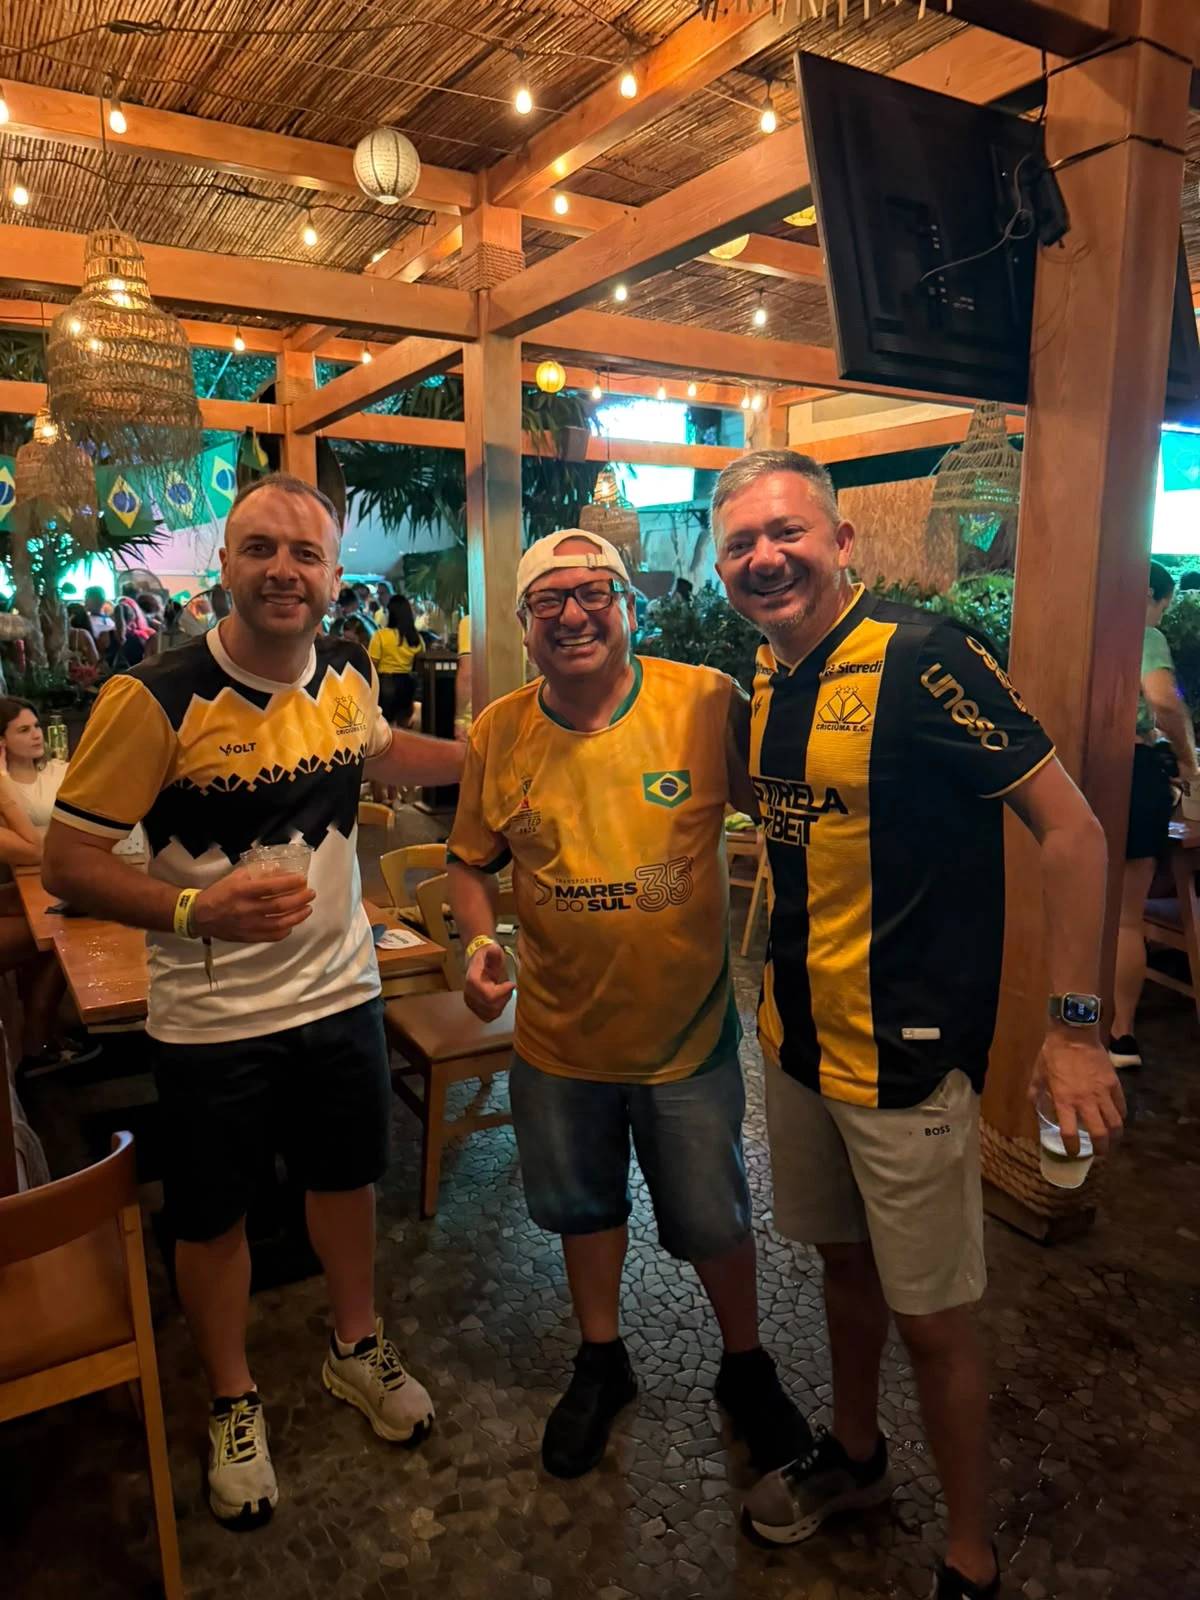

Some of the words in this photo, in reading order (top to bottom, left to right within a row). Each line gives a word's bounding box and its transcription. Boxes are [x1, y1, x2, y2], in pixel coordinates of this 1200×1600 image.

[838, 660, 883, 674] Sicredi
[219, 742, 256, 756] VOLT
[771, 807, 819, 846] BET
[555, 882, 638, 899] MARES
[635, 856, 692, 912] 35
[556, 899, 584, 912] DO
[588, 897, 631, 912] SUL
[924, 1124, 951, 1137] BOSS
